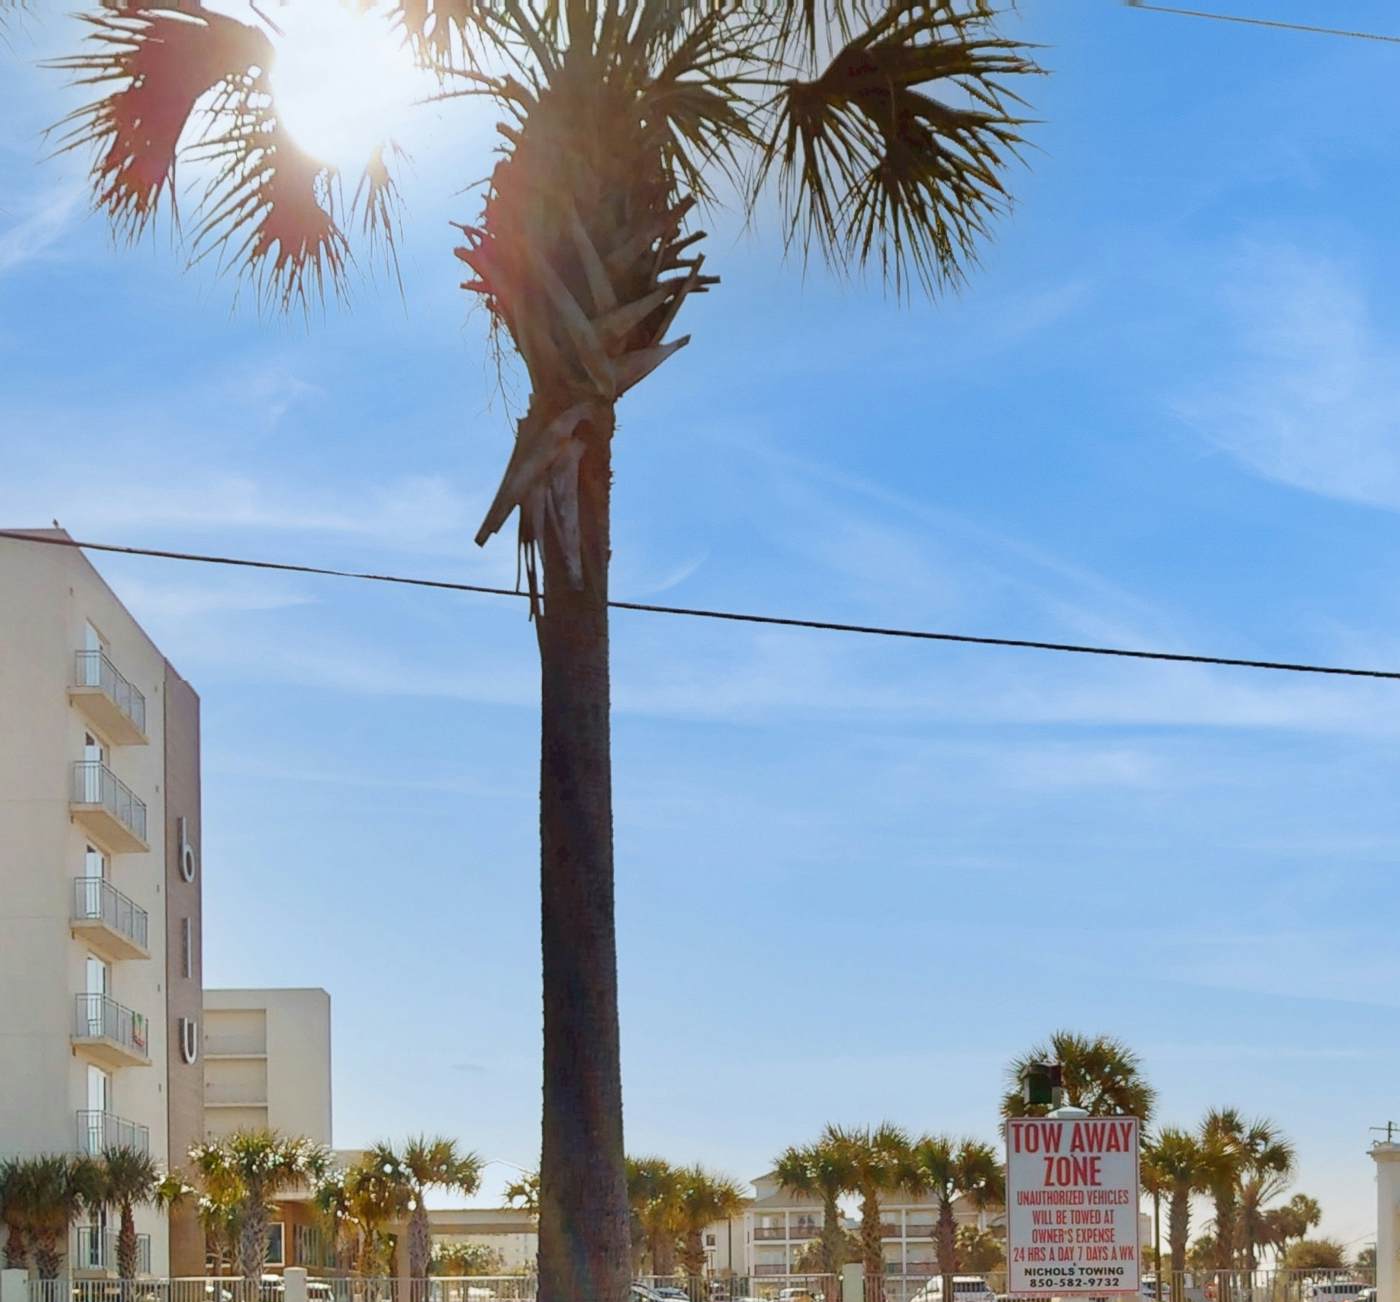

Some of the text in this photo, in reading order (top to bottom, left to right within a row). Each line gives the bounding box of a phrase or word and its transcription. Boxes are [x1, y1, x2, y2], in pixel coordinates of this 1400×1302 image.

[1011, 1122, 1133, 1153] TOW AWAY
[1043, 1156, 1103, 1187] ZONE
[1017, 1189, 1129, 1206] UNAUTHORIZED VEHICLES
[1032, 1209, 1115, 1225] WILL BE TOWED AT
[1032, 1228, 1115, 1244] OWNER'S EXPENSE
[1013, 1246, 1134, 1262] 24 HRS A DAY 7 DAYS A WK
[1024, 1266, 1124, 1276] NICHOLS TOWING
[1030, 1277, 1120, 1288] 850-582-9732
